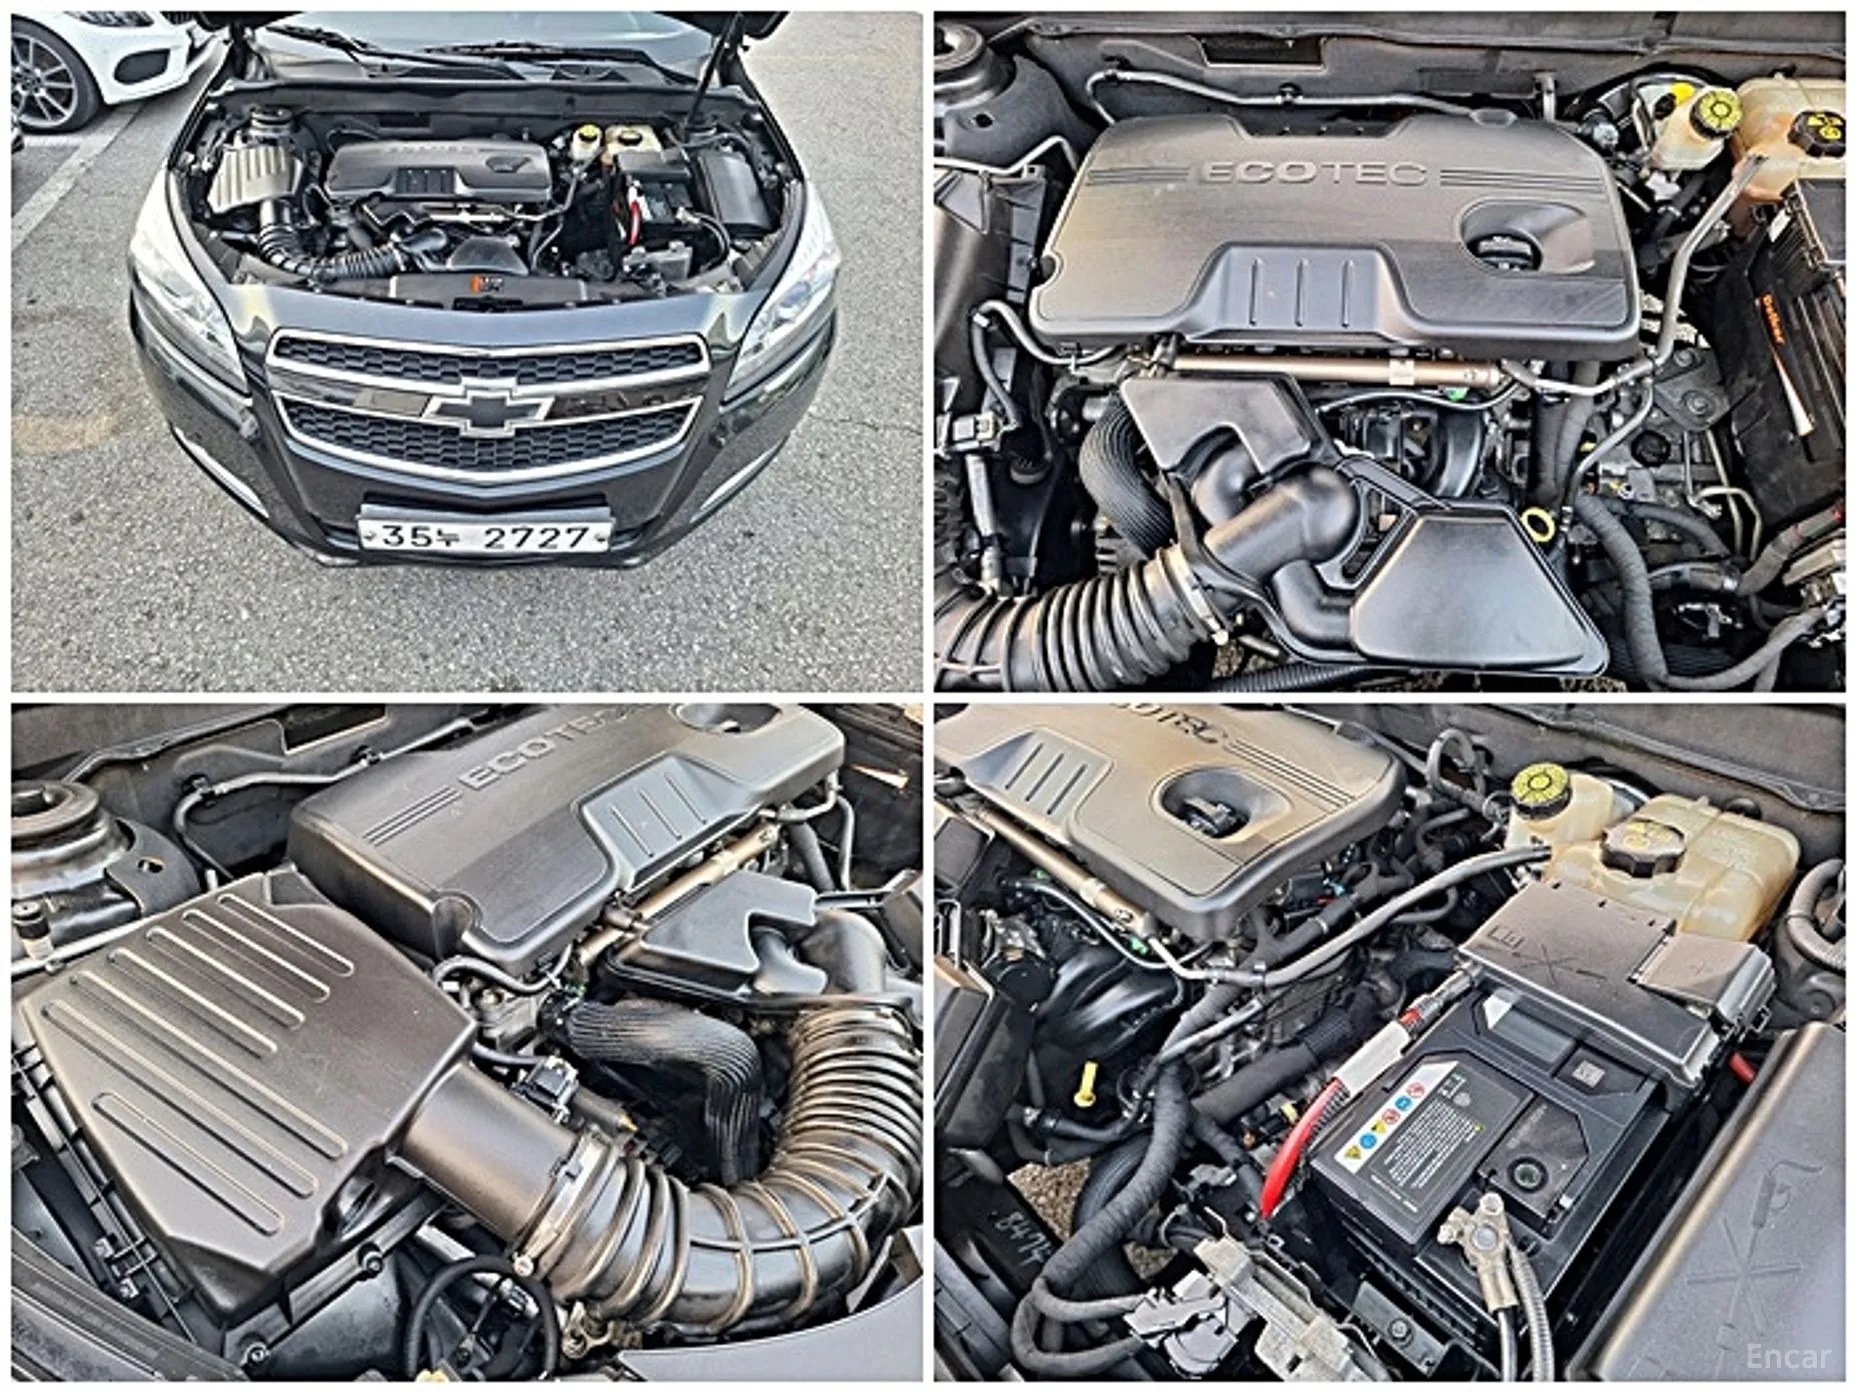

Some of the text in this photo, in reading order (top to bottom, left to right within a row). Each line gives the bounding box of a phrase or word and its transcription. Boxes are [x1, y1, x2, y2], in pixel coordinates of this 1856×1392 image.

[1200, 160, 1429, 187] ECOTEC
[381, 524, 590, 550] 35누 2727
